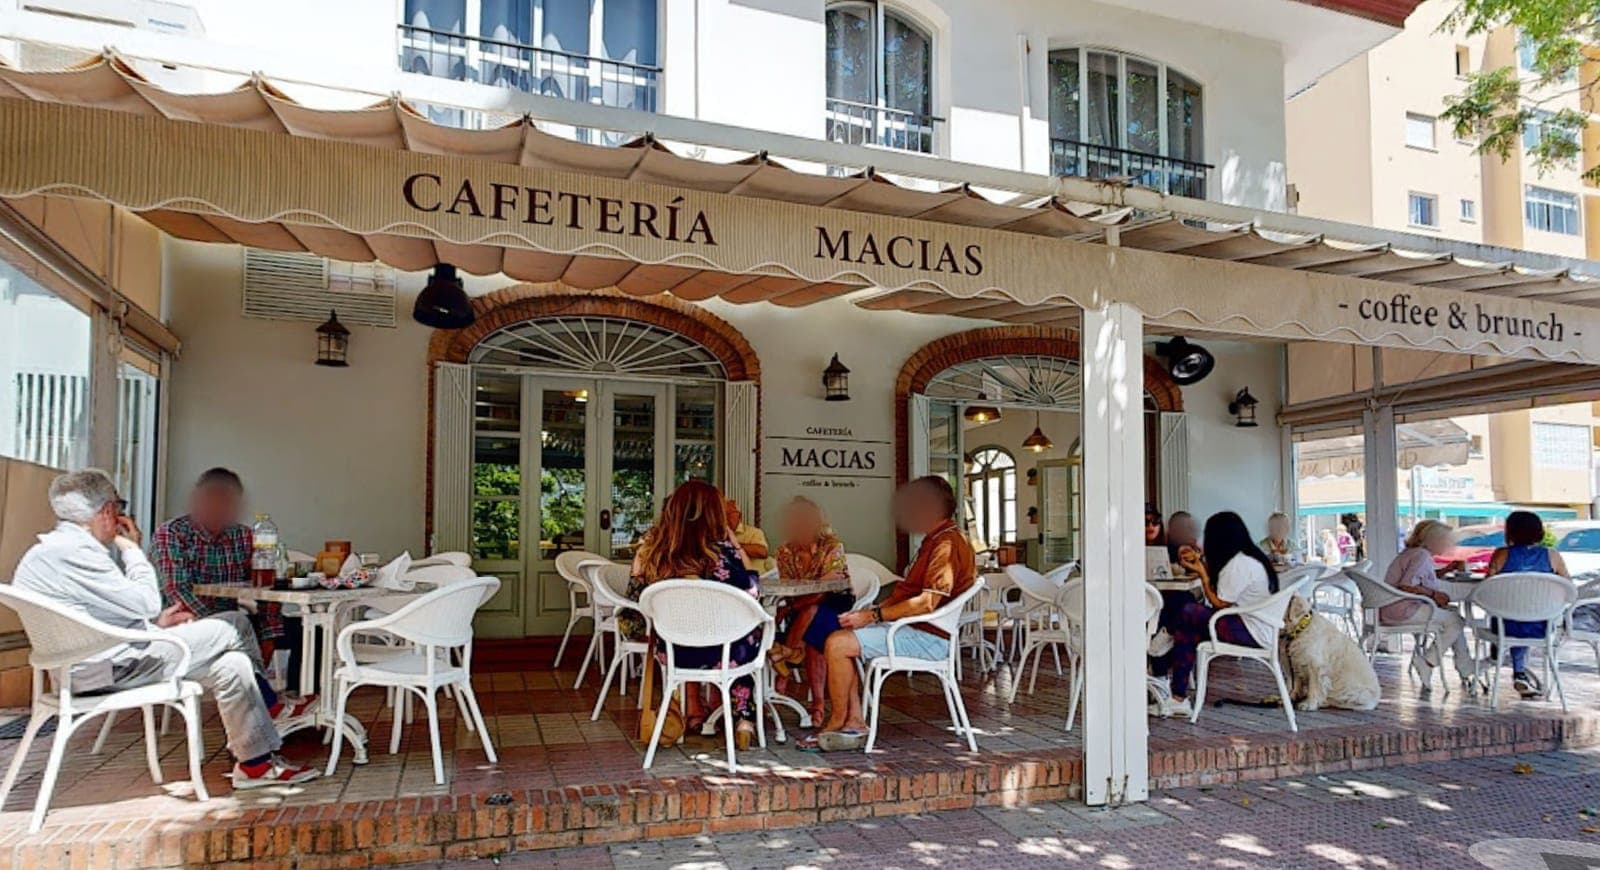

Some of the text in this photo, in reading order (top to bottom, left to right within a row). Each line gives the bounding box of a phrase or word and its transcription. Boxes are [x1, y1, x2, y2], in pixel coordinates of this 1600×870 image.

[402, 173, 983, 276] CAFETERÍA MACIAS
[1358, 294, 1439, 327] coffee
[1448, 302, 1468, 331] &
[1475, 303, 1564, 342] brunch
[806, 427, 853, 436] CAFETERÍA
[781, 447, 876, 470] MACIAS
[802, 479, 822, 487] coffee
[831, 479, 856, 488] brunch
